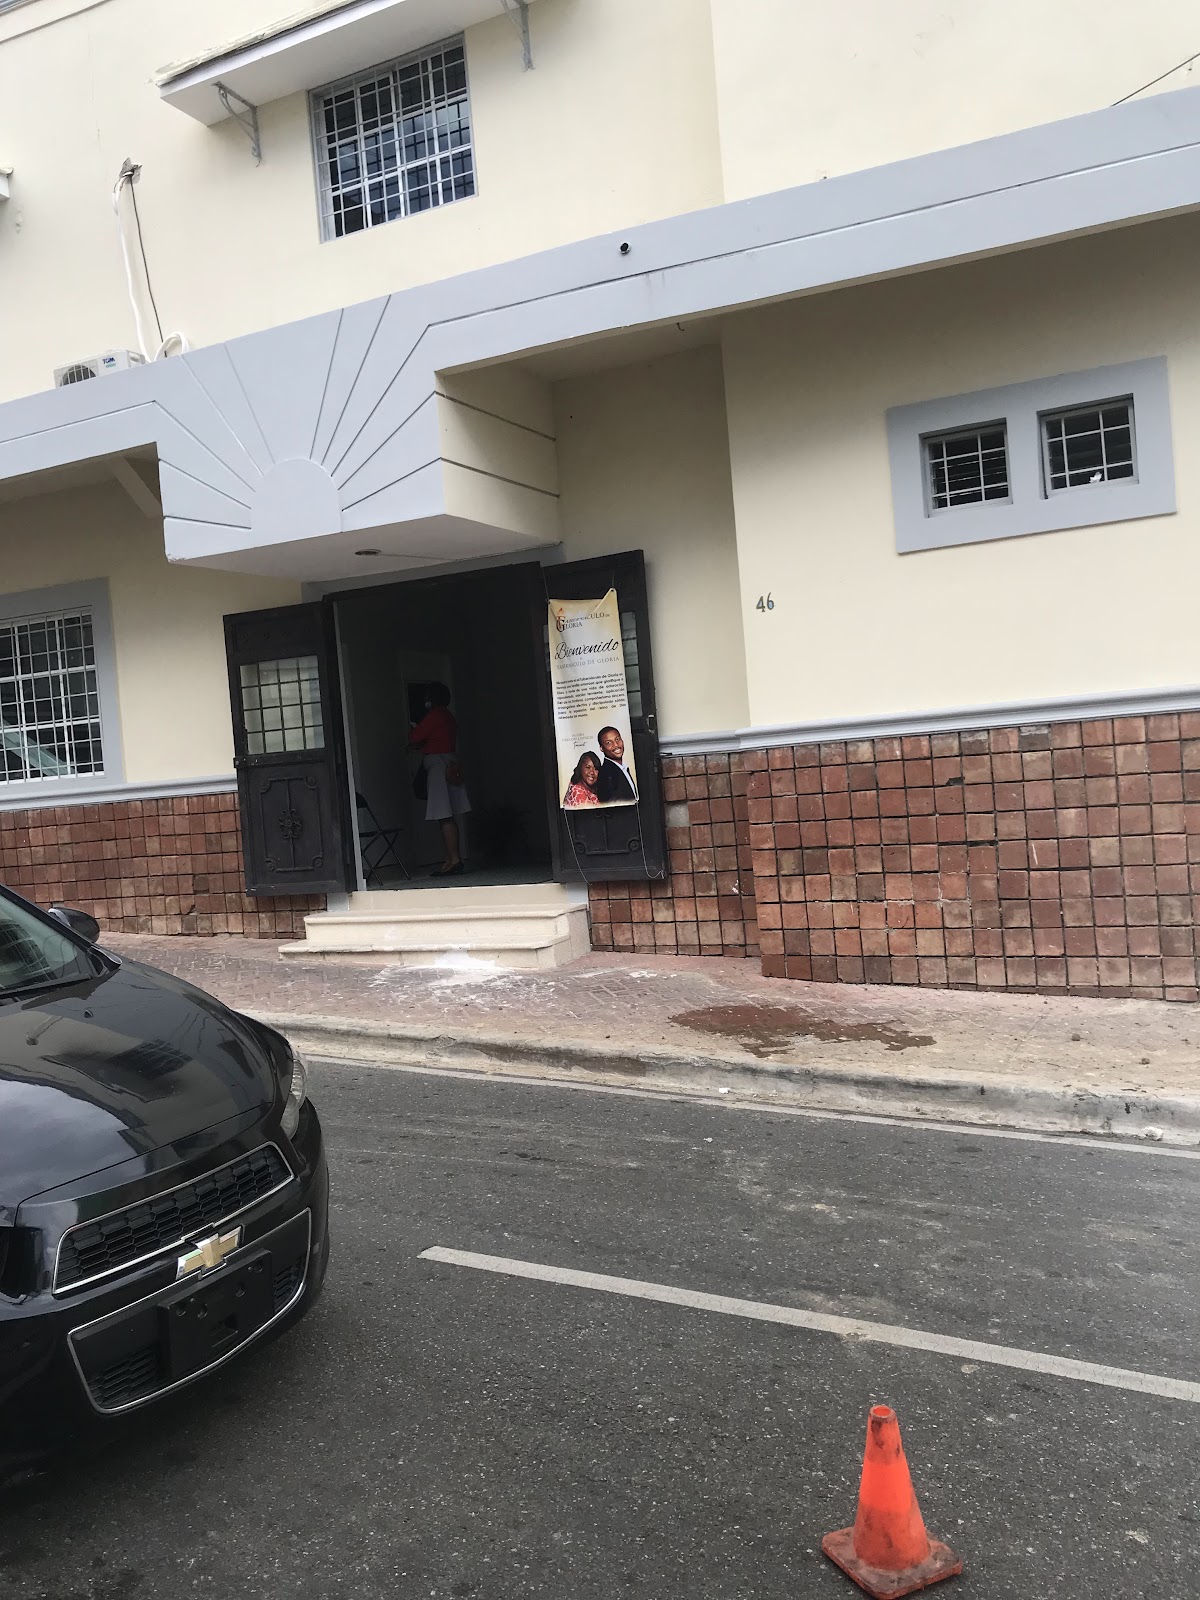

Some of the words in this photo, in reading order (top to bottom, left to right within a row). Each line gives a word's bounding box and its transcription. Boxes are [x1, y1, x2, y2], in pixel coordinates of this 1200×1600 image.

[756, 592, 775, 613] 46
[556, 619, 583, 632] GLORIA
[554, 639, 619, 660] Bienvenido
[596, 656, 620, 664] GLORIA
